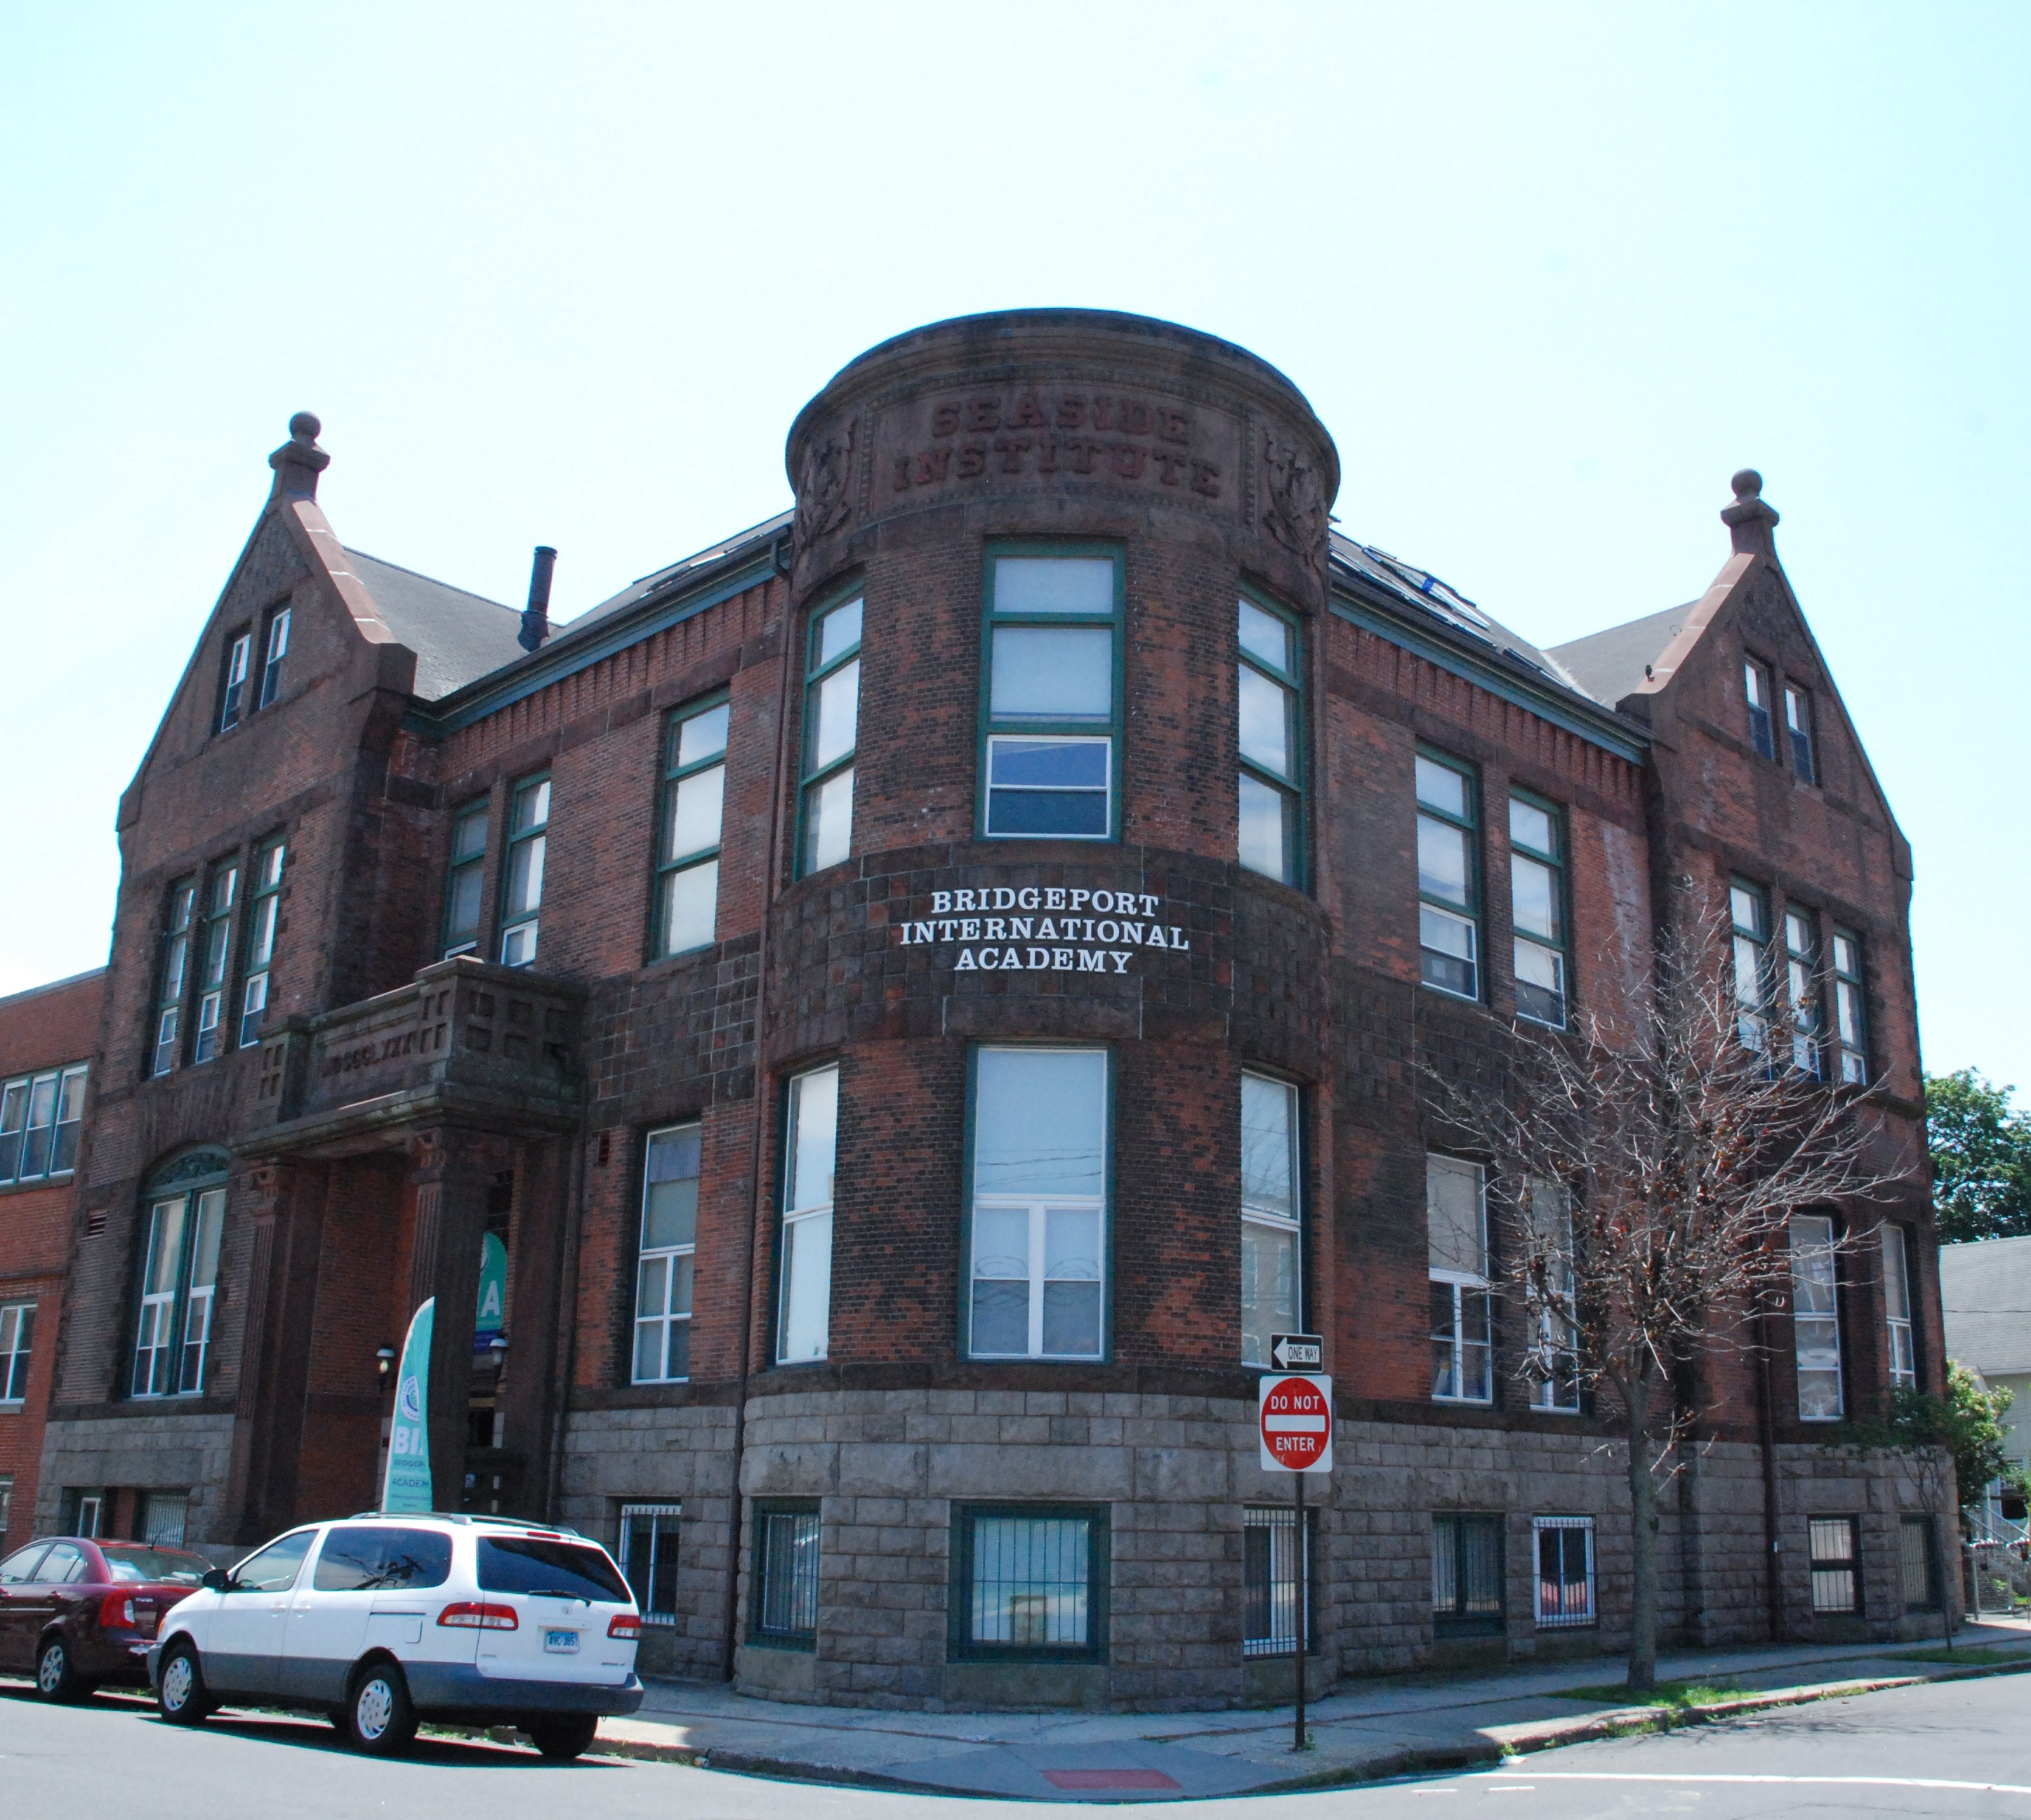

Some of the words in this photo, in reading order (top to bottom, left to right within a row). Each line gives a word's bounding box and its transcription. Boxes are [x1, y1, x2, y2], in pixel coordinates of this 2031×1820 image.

[932, 393, 1190, 446] SEASIDE
[893, 437, 1221, 499] INSTITUTE
[931, 888, 1158, 917] BRIDGEPORT
[899, 917, 1189, 950] INTERNATIONAL
[953, 947, 1133, 974] ACADEMY
[1288, 1346, 1302, 1360] ONE
[1304, 1347, 1318, 1361] WAY
[1271, 1395, 1288, 1410] DO
[1294, 1395, 1320, 1410] NOT
[1276, 1437, 1315, 1452] ENTER
